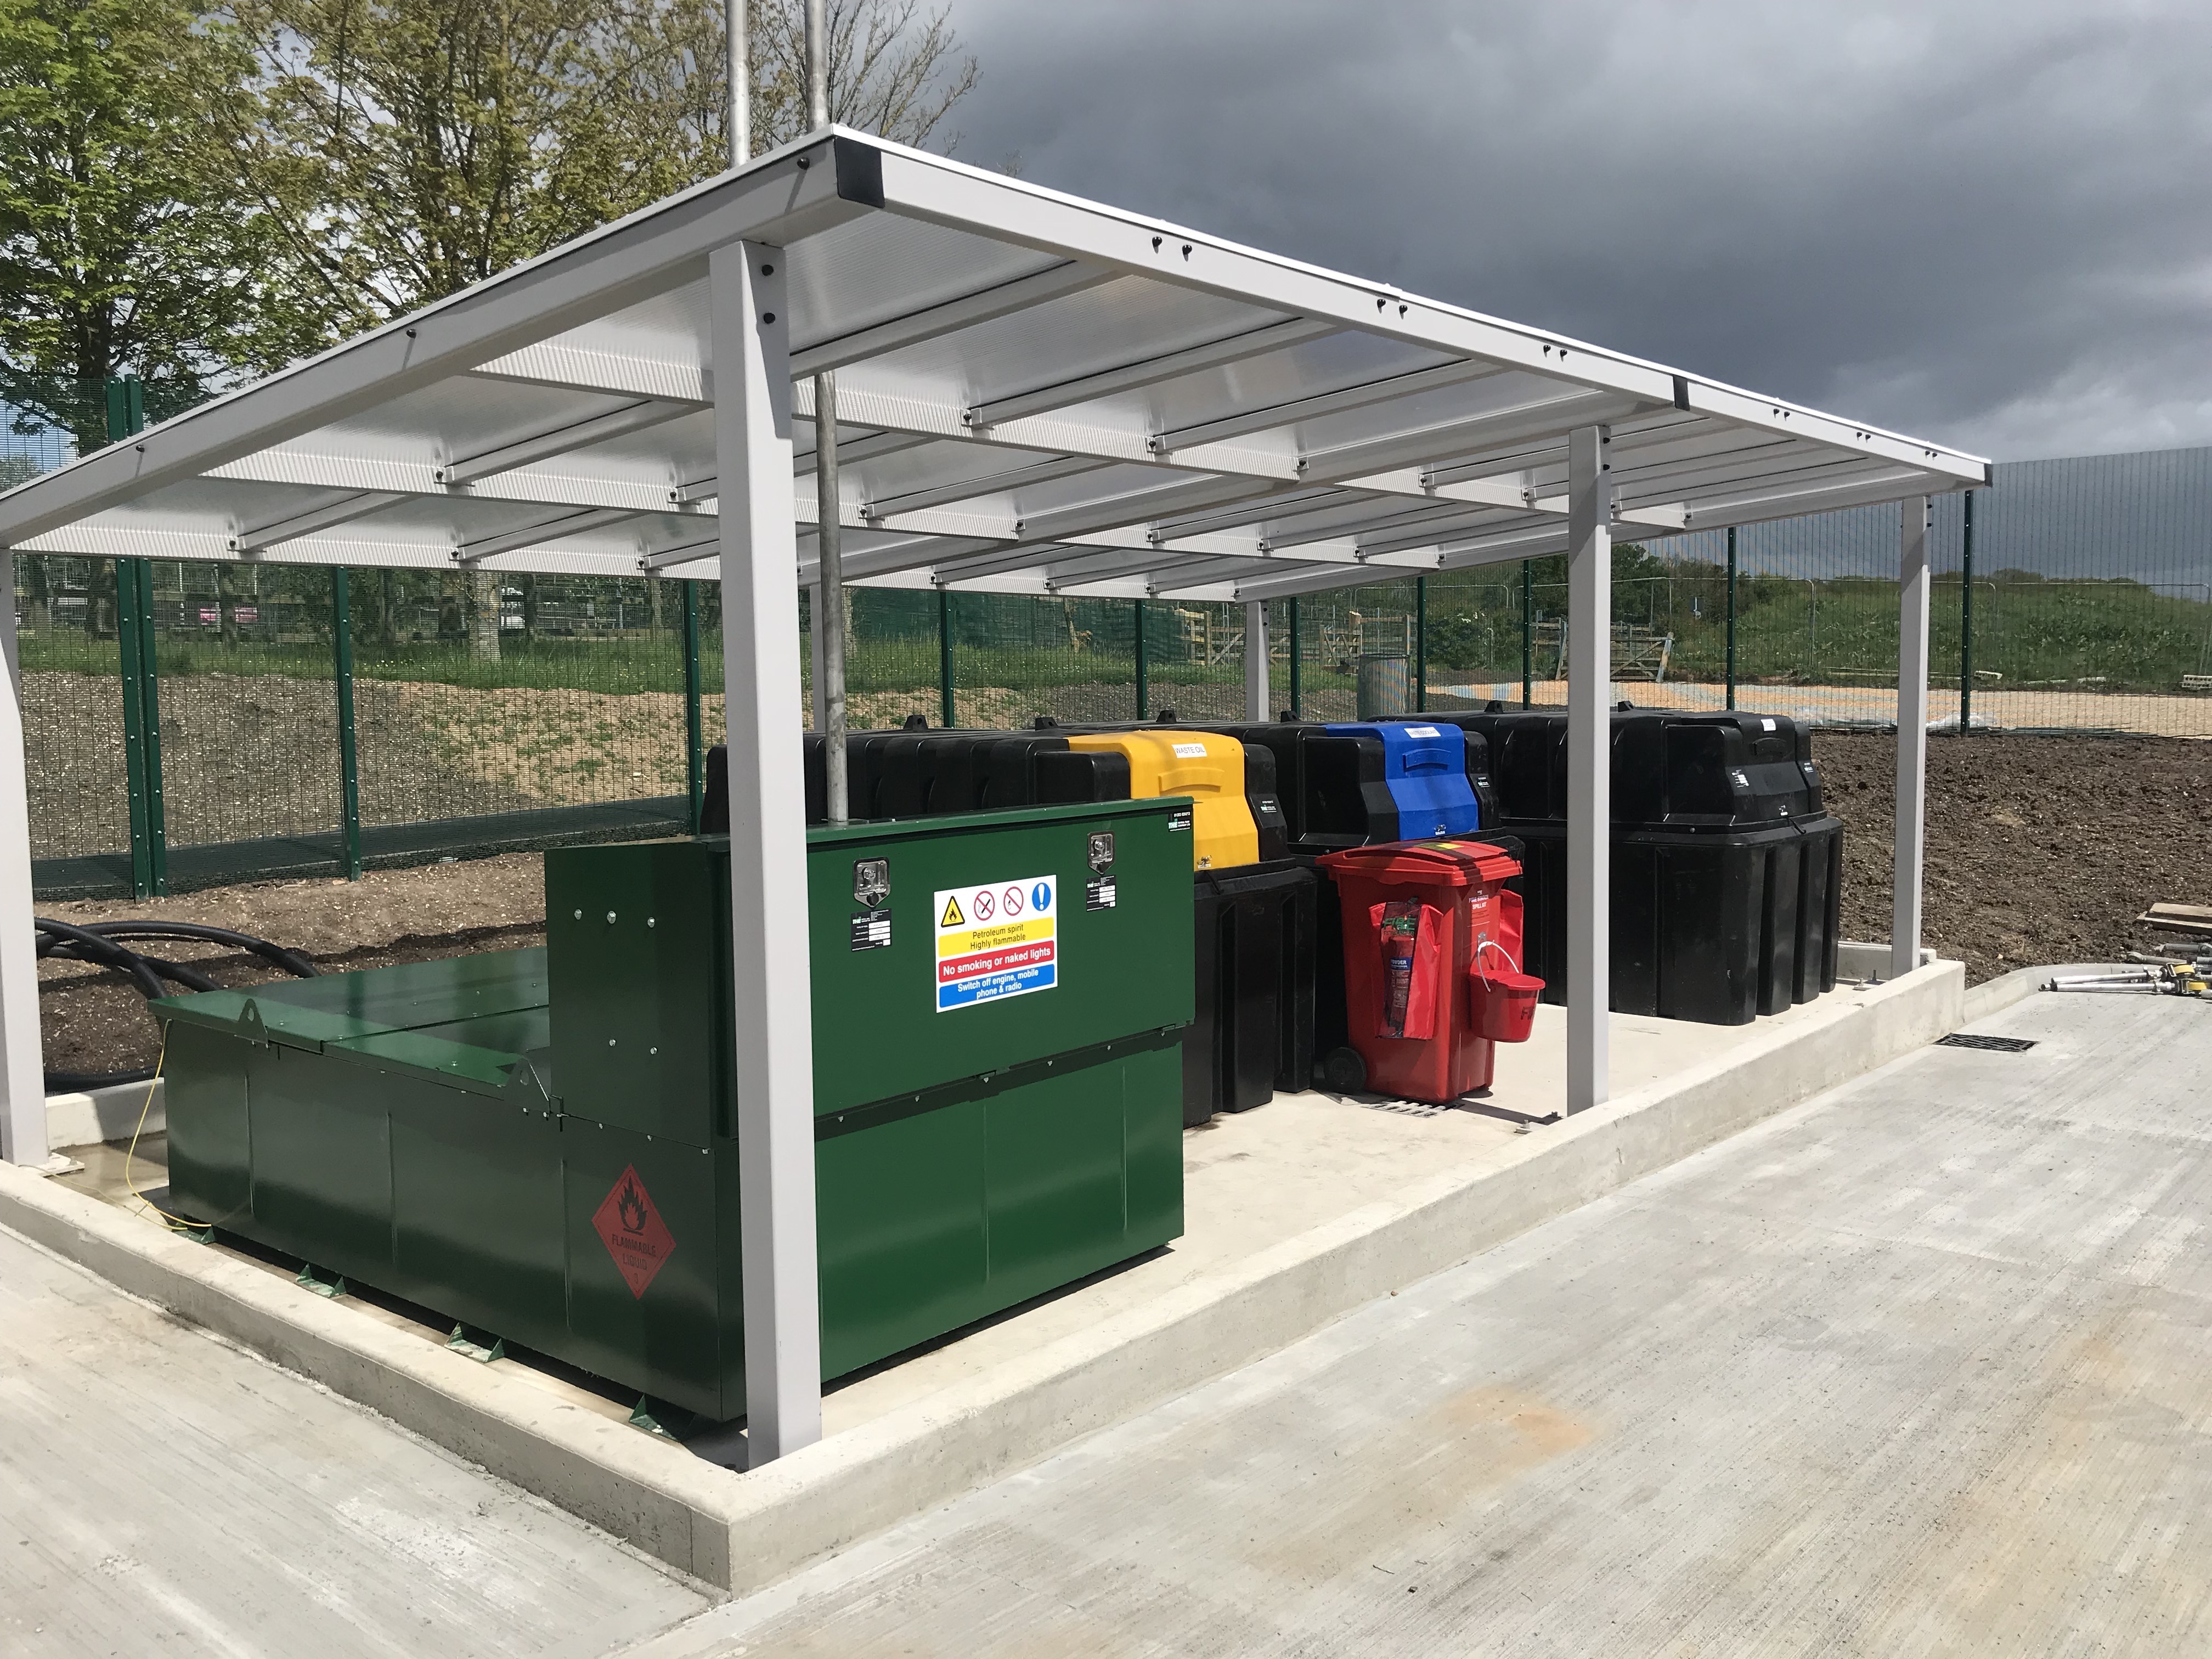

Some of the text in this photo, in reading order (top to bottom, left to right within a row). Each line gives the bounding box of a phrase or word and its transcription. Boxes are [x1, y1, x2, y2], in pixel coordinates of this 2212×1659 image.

[973, 924, 1024, 939] Petroleum spirit
[1384, 917, 1417, 930] FIRE
[970, 934, 1026, 950] Highly flammable
[943, 947, 1051, 976] No smoking or naked lights
[958, 969, 1039, 992] Switch off engine, mobile
[977, 987, 997, 1000] phone
[1005, 982, 1022, 991] radio
[612, 1233, 656, 1257] FLAMMABLE
[623, 1253, 647, 1271] LIQUID
